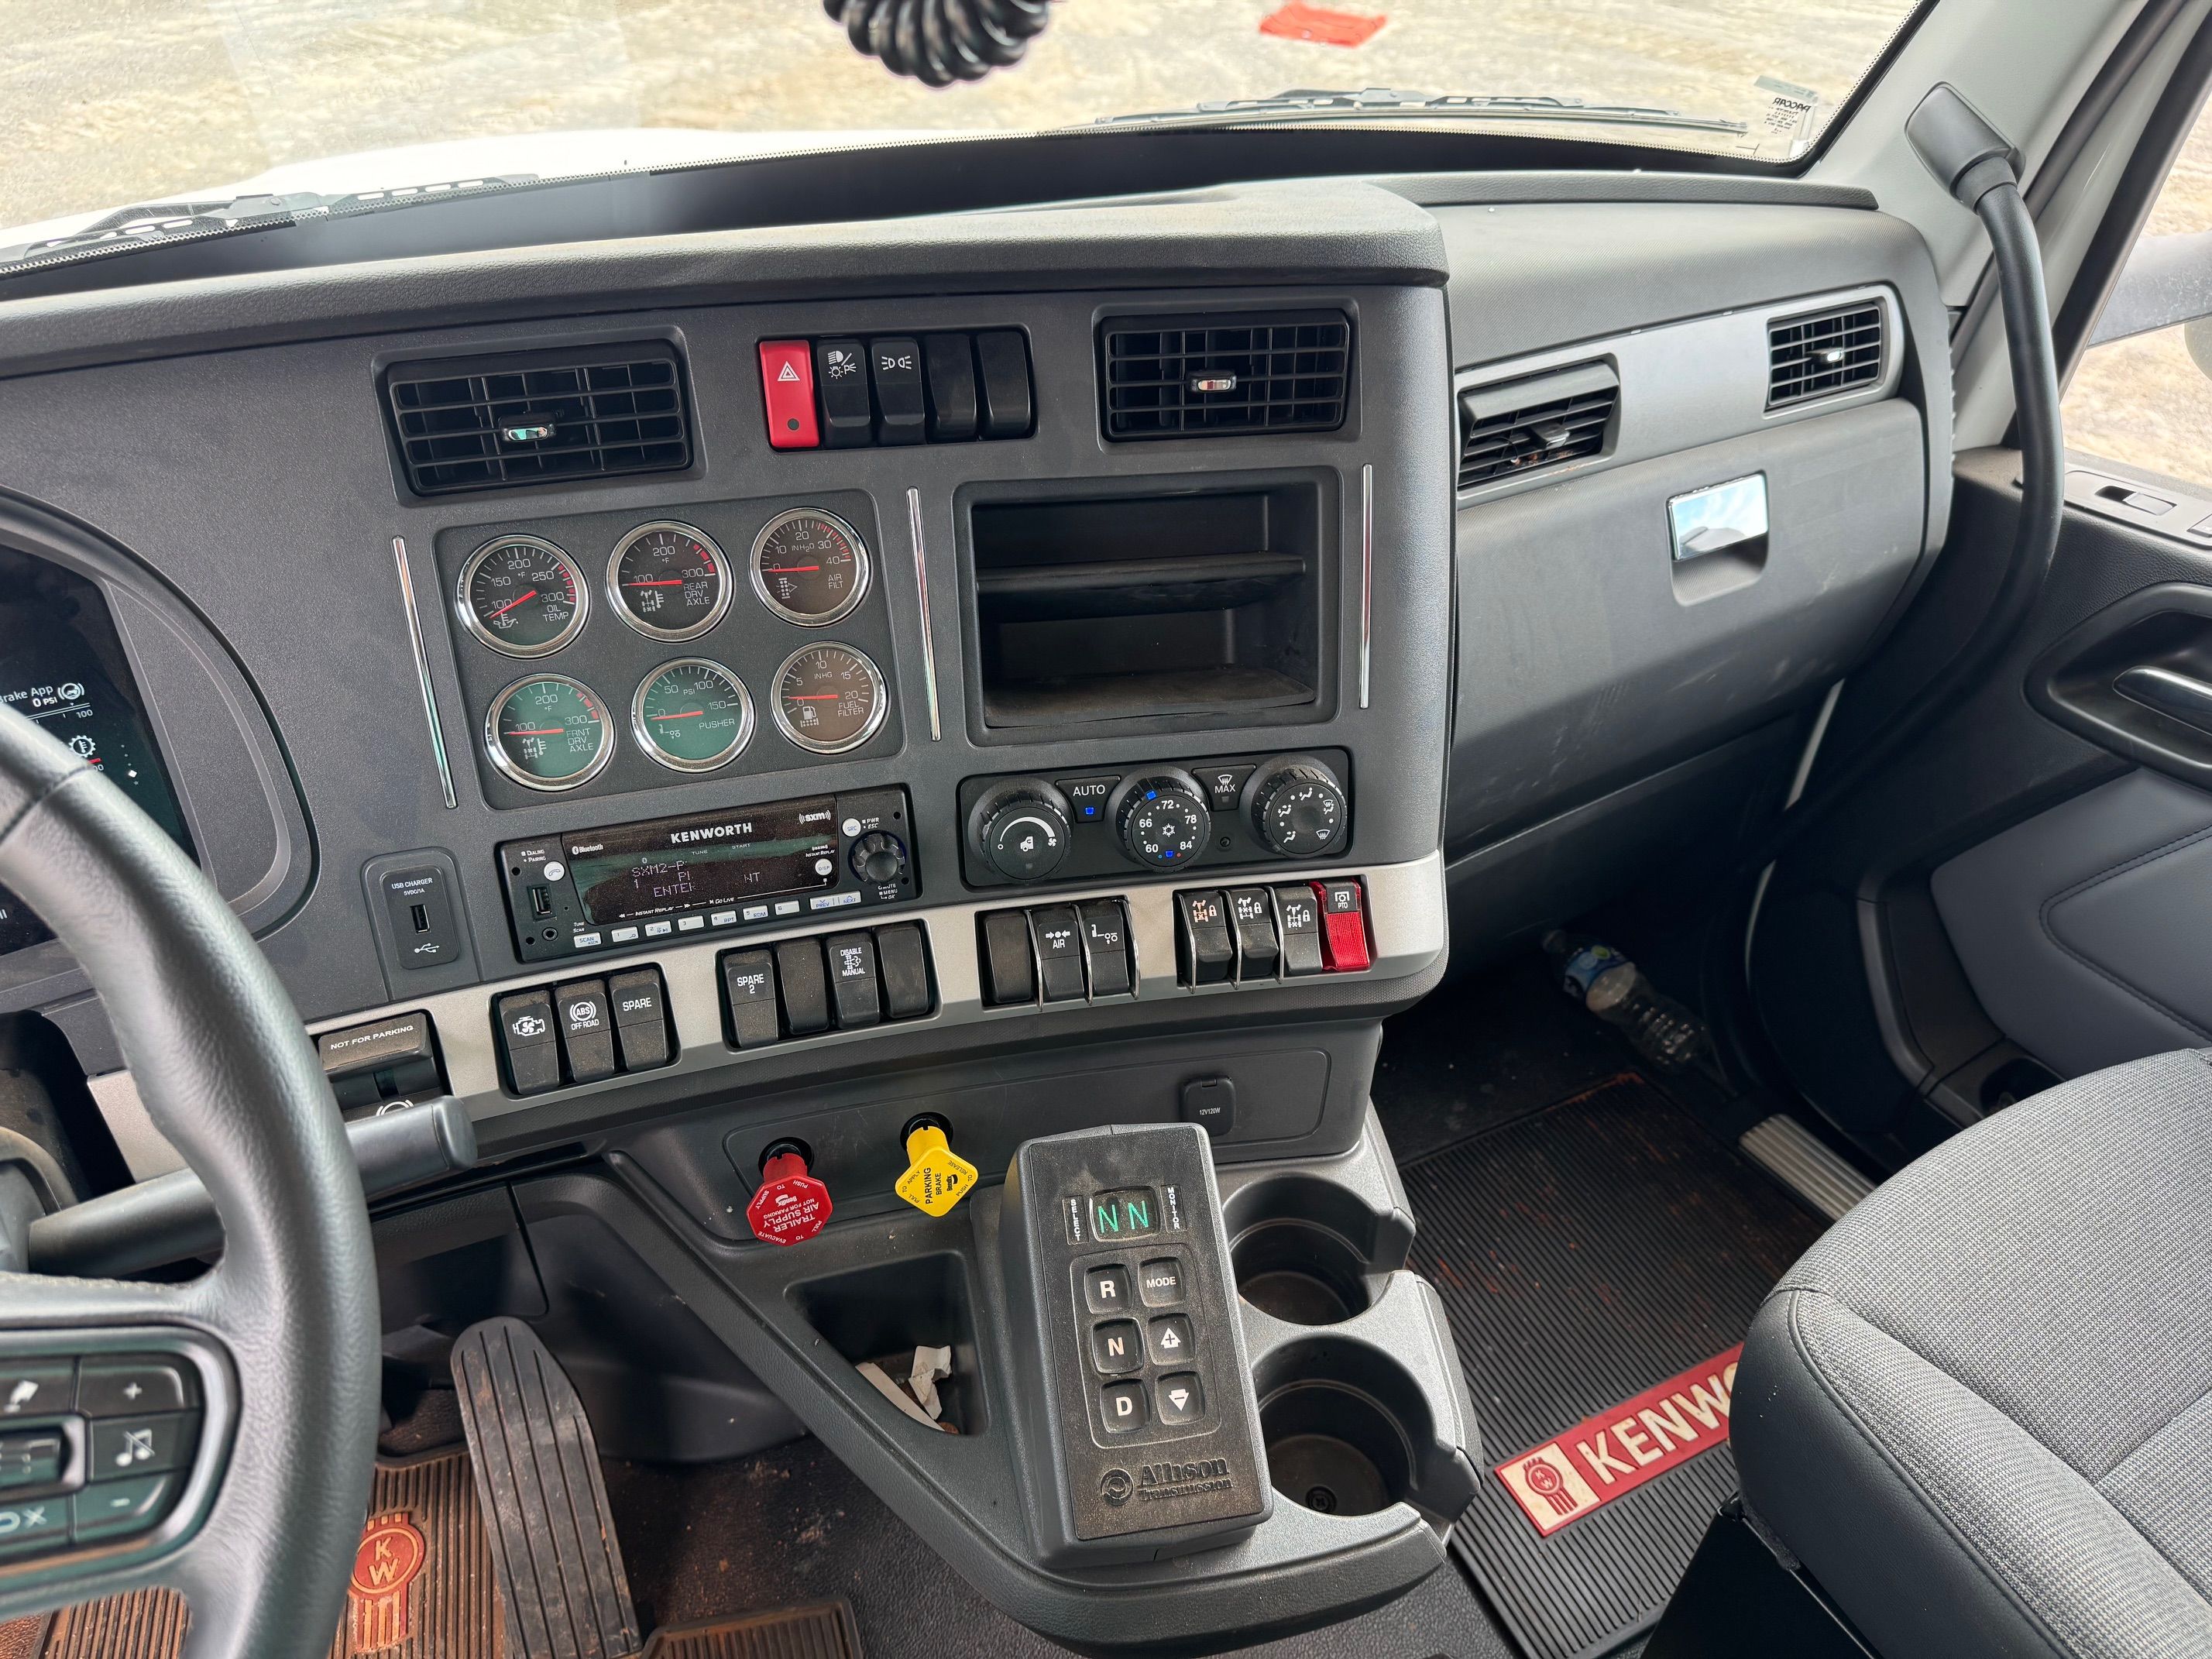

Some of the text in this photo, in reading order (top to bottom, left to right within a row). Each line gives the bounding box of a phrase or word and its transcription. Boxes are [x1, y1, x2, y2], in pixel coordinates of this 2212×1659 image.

[795, 531, 809, 541] 20
[776, 545, 787, 555] 10
[818, 541, 831, 549] 30
[653, 546, 675, 556] 200
[507, 558, 531, 570] 200
[826, 556, 840, 565] 40
[531, 571, 555, 582] 250
[682, 568, 703, 579] 300
[491, 577, 511, 587] 150
[634, 574, 653, 584] 100
[683, 582, 708, 591] REAR
[828, 580, 843, 589] FILT
[541, 592, 564, 603] 300
[686, 596, 710, 606] AXLE
[492, 599, 513, 610] 100
[542, 612, 568, 622] TEMP
[816, 660, 827, 669] 10
[840, 671, 851, 681] 15
[694, 680, 713, 691] 100
[795, 678, 802, 686] 5
[31, 686, 53, 697] App
[664, 685, 678, 694] 50
[844, 690, 858, 699] 20
[33, 699, 41, 707] 0
[534, 694, 558, 706] 200
[708, 700, 726, 710] 150
[797, 698, 805, 706] 0
[838, 701, 859, 709] FUEL
[76, 709, 93, 719] 100
[838, 707, 864, 717] FILTER
[565, 715, 588, 726] 300
[699, 719, 735, 730] PUSHER
[515, 722, 535, 732] 100
[566, 728, 590, 737] FRNT
[568, 736, 587, 744] DRV
[570, 743, 594, 752] AXLE
[1073, 785, 1105, 796] AUTO
[1215, 785, 1235, 793] MAX
[1162, 800, 1174, 809] 72
[1139, 819, 1152, 828] 66
[1185, 815, 1197, 824] 78
[671, 823, 752, 844] KENWORTH
[579, 843, 603, 854] Bluetooth
[1180, 841, 1193, 850] 84
[405, 878, 433, 888] CHARGER
[1053, 939, 1066, 949] AIR
[840, 947, 862, 957] DISABLE
[842, 968, 865, 977] MANUAL
[737, 974, 764, 987] SPARE
[749, 984, 755, 994] 2
[623, 998, 652, 1011] SPARE
[576, 1007, 590, 1016] ABS
[583, 1018, 599, 1028] ROAD
[331, 1025, 414, 1049] NOT FOR PARKING
[948, 1160, 967, 1174] RELEASE
[908, 1170, 920, 1184] APPLY
[792, 1179, 809, 1188] PUSH
[957, 1184, 969, 1197] PUSH
[756, 1190, 770, 1209] SUPPLY
[777, 1196, 797, 1207] Bendix
[764, 1207, 788, 1219] PARKING
[1167, 1187, 1180, 1229] MONITOR
[764, 1202, 819, 1228] AIR SUPPLY
[1070, 1199, 1080, 1241] SELECT
[773, 1214, 815, 1231] TRAILER
[812, 1221, 822, 1233] PULL
[757, 1231, 786, 1244] EVACUATE
[1146, 1276, 1176, 1288] MODE
[1100, 1280, 1115, 1298] R
[1108, 1337, 1125, 1356] N
[1115, 1396, 1133, 1416] D
[1142, 1458, 1230, 1486] Allison
[1137, 1478, 1233, 1501] Transmission
[376, 1537, 393, 1561] K
[368, 1558, 399, 1585] W
